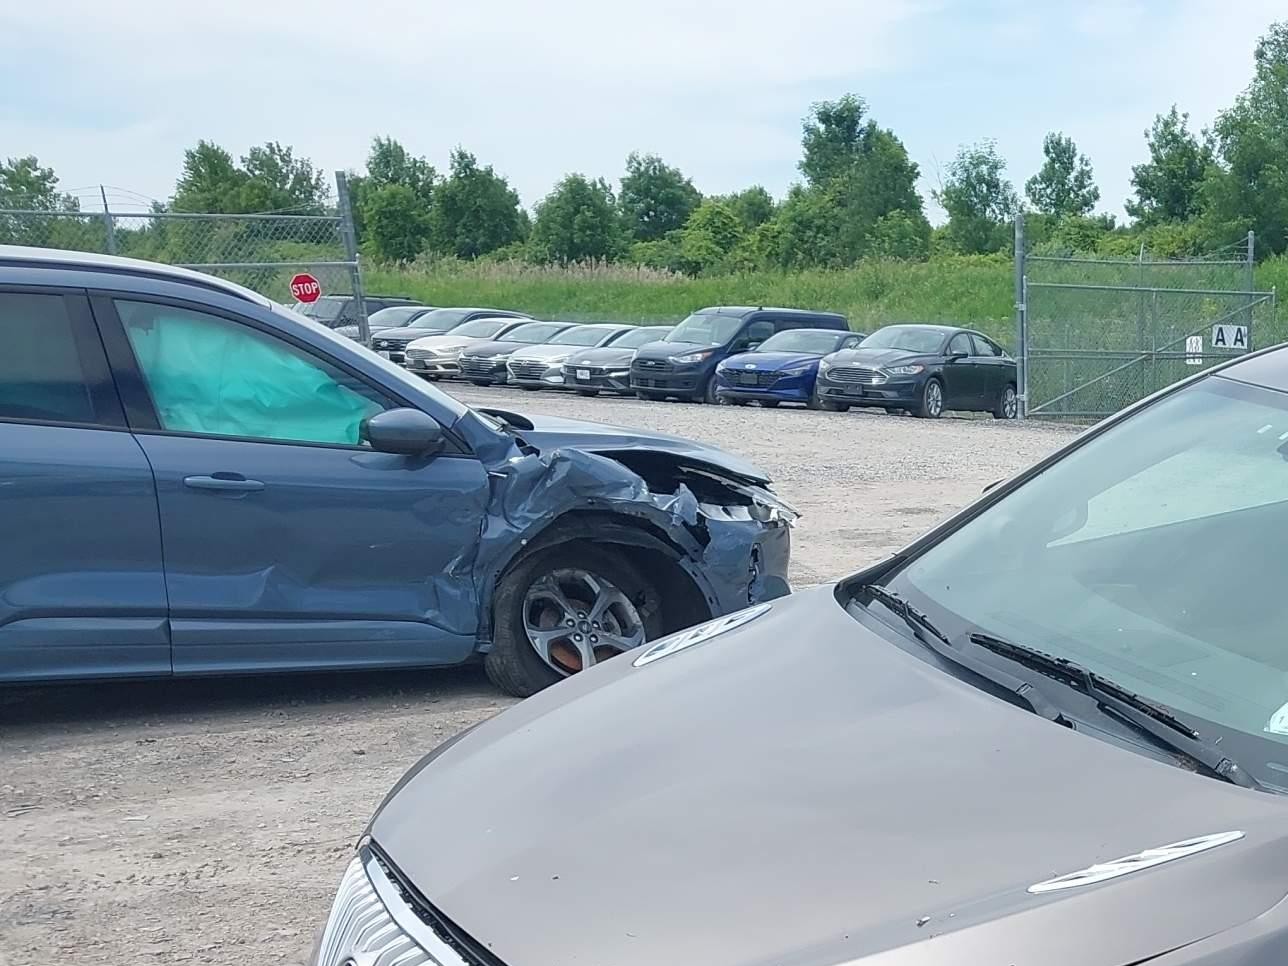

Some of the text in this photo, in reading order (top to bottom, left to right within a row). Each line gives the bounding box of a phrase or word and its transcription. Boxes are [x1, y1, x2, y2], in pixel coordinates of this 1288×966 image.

[292, 282, 318, 296] STOP
[1214, 326, 1245, 347] A A
